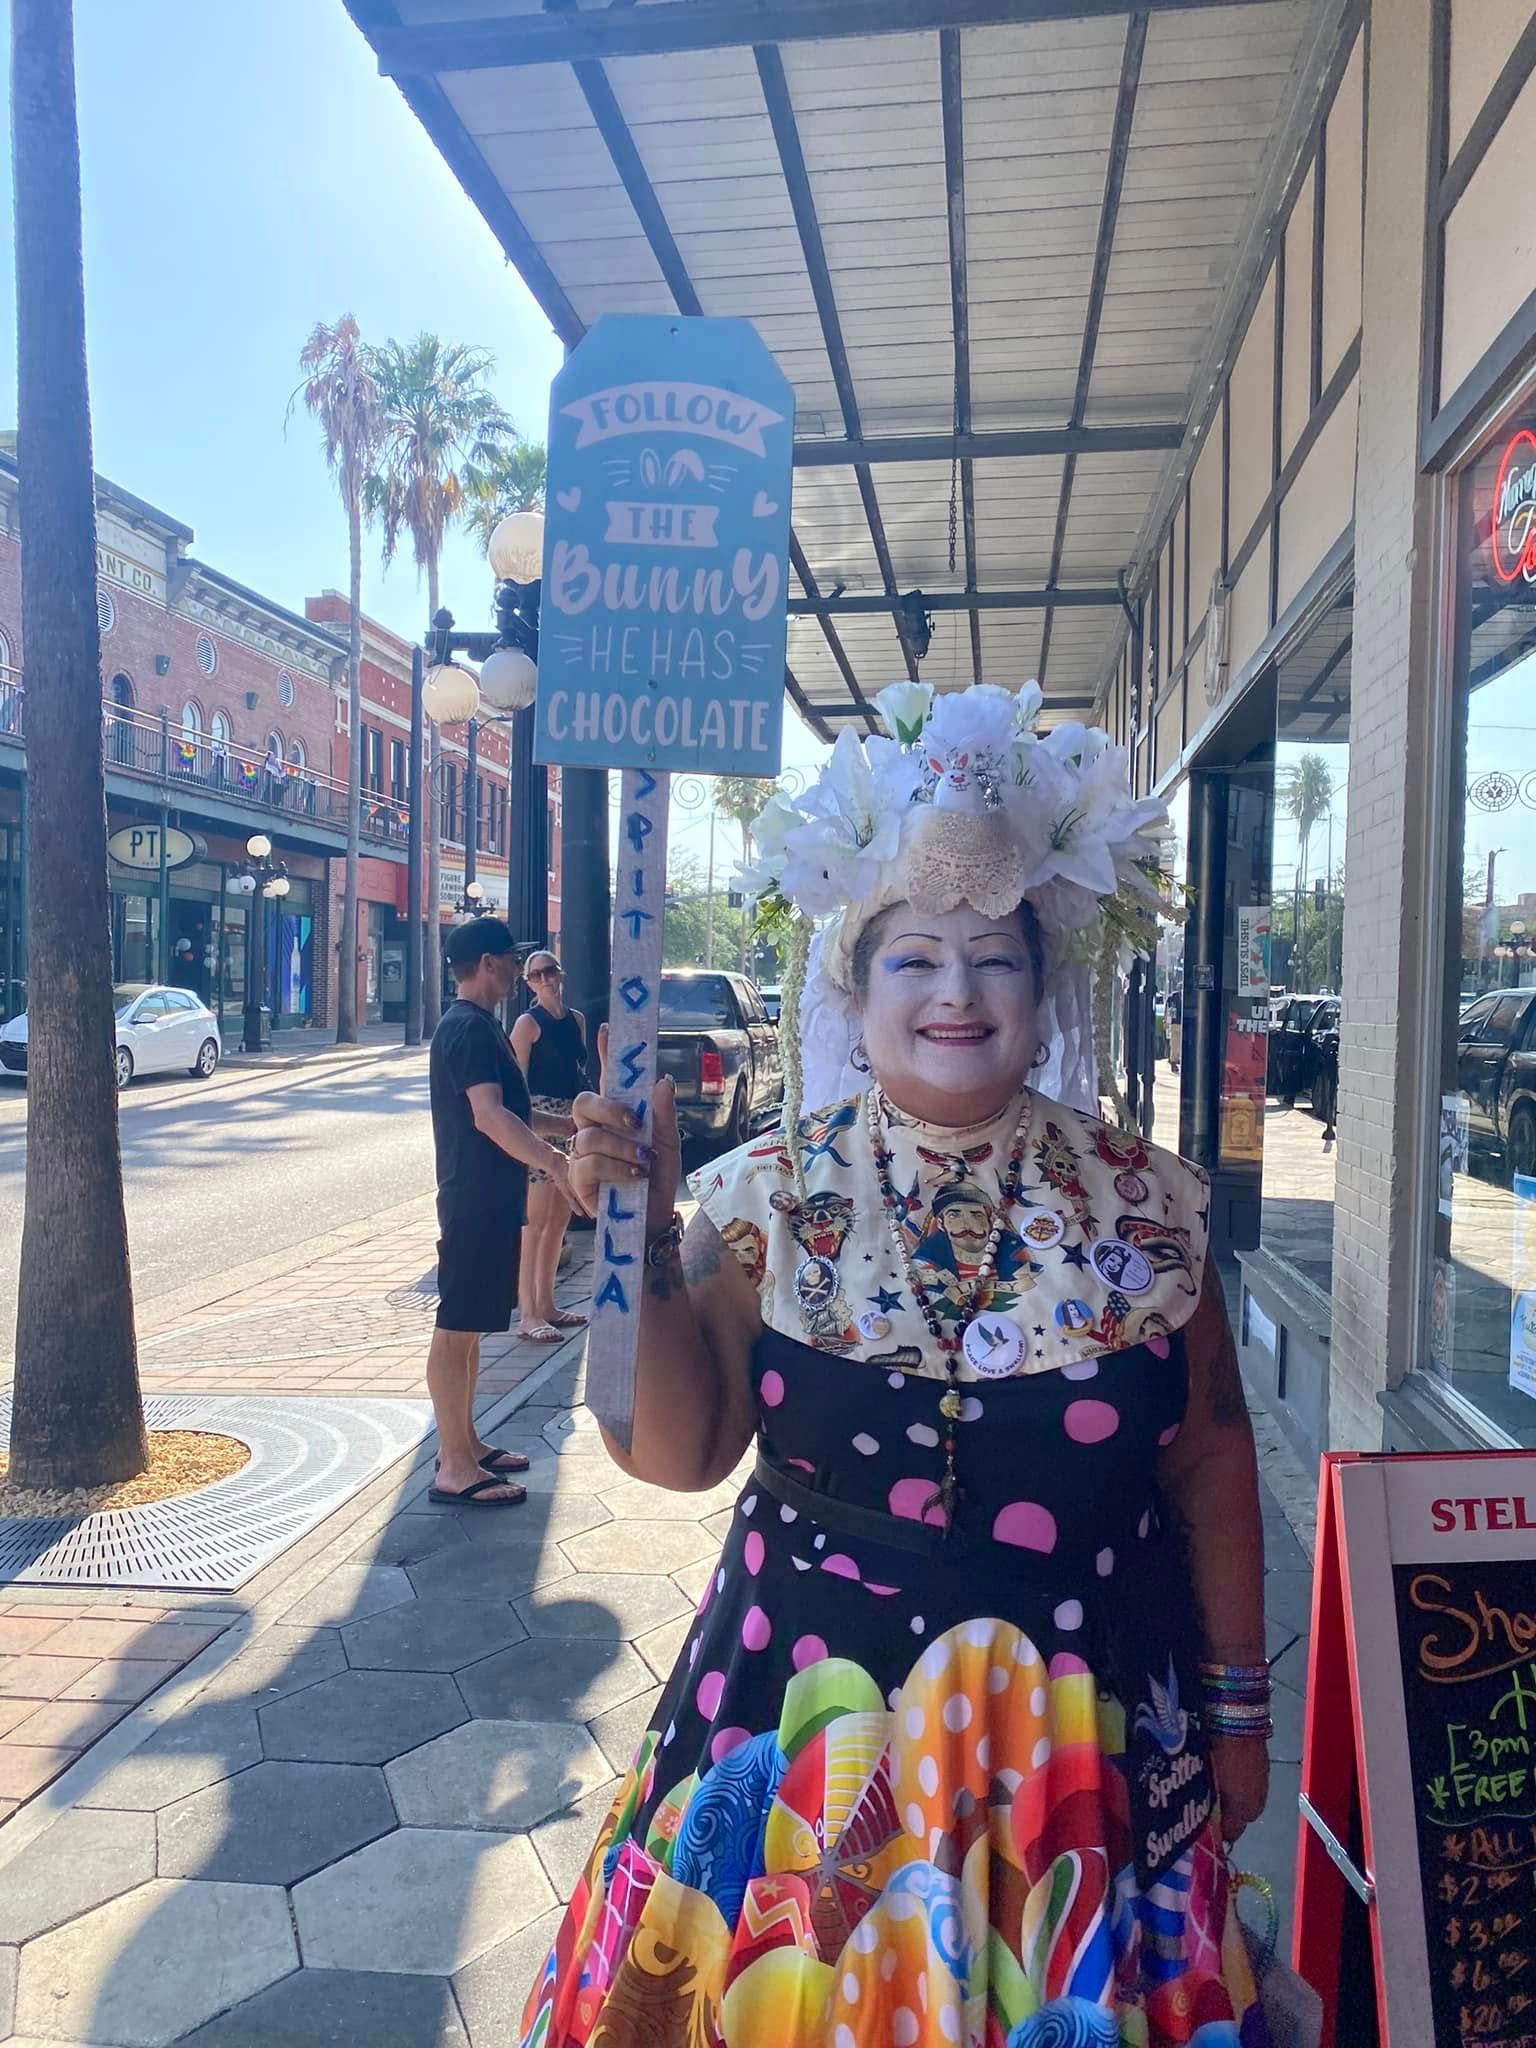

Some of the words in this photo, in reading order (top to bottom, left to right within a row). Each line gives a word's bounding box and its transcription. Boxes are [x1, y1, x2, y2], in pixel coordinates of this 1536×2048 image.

[589, 391, 758, 435] FOLLOW
[627, 506, 697, 542] THE
[133, 567, 156, 594] CO.
[547, 690, 769, 752] CHOCOLATE
[130, 831, 171, 858] PT
[1240, 918, 1249, 957] SLUSHIE
[1240, 959, 1249, 988] TIPSY
[966, 1343, 978, 1366] PEACE
[978, 1364, 995, 1375] LOVE
